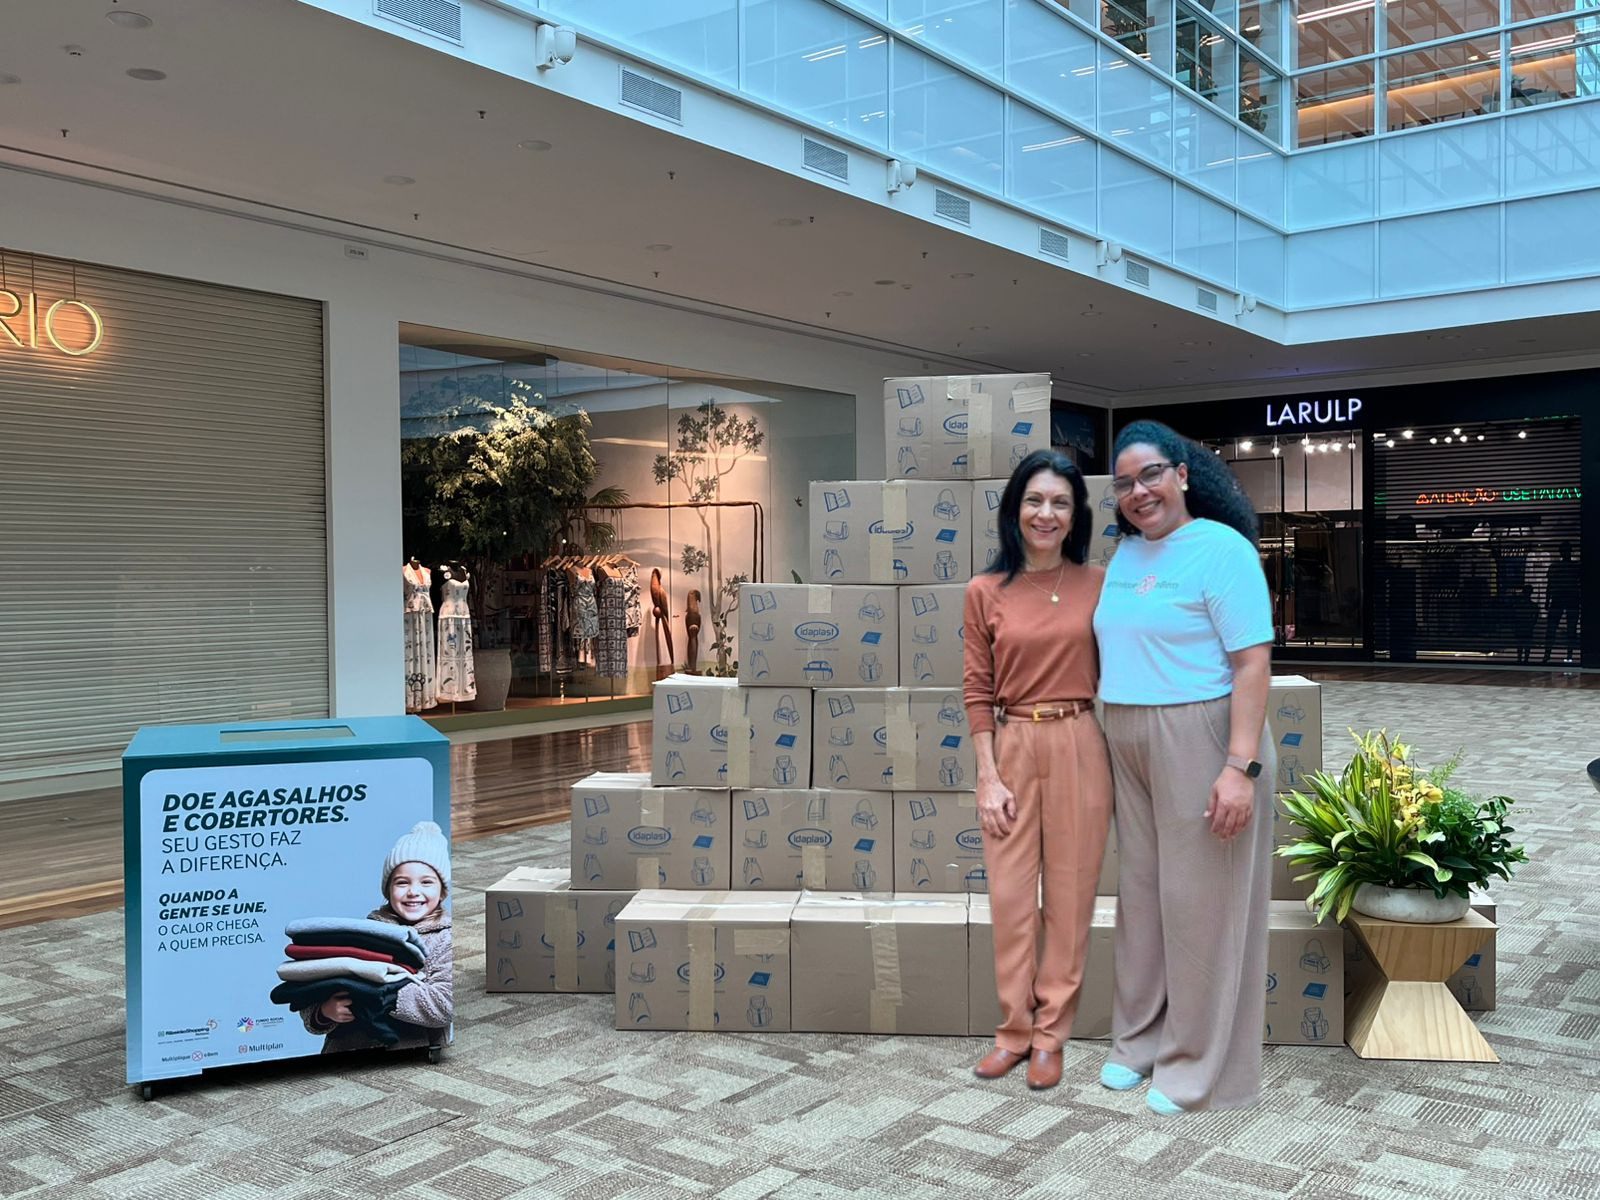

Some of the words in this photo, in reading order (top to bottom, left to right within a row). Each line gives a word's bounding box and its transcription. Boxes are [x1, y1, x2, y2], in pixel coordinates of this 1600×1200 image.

[1266, 398, 1362, 426] LARULP
[800, 627, 834, 637] idaplast
[162, 792, 217, 812] DOE
[219, 784, 368, 809] AGASALHOS
[162, 815, 180, 832] E
[184, 805, 350, 831] COBERTORES.
[161, 836, 199, 854] SEU
[204, 832, 265, 850] GESTO
[270, 830, 301, 847] FAZ
[793, 834, 828, 845] idaplast
[161, 859, 175, 874] A
[180, 852, 287, 873] DIFERENÇA.
[159, 889, 226, 906] QUANDO
[227, 888, 239, 900] A
[159, 906, 209, 920] GENTE
[211, 903, 232, 916] SE
[233, 901, 267, 915] UNE,
[158, 925, 168, 936] O
[171, 922, 213, 935] CALOR
[216, 918, 259, 931] CHEGA
[158, 941, 167, 952] A
[169, 938, 209, 952] QUEM
[212, 933, 265, 947] PRECISA.
[249, 1042, 284, 1053] Multiplan
